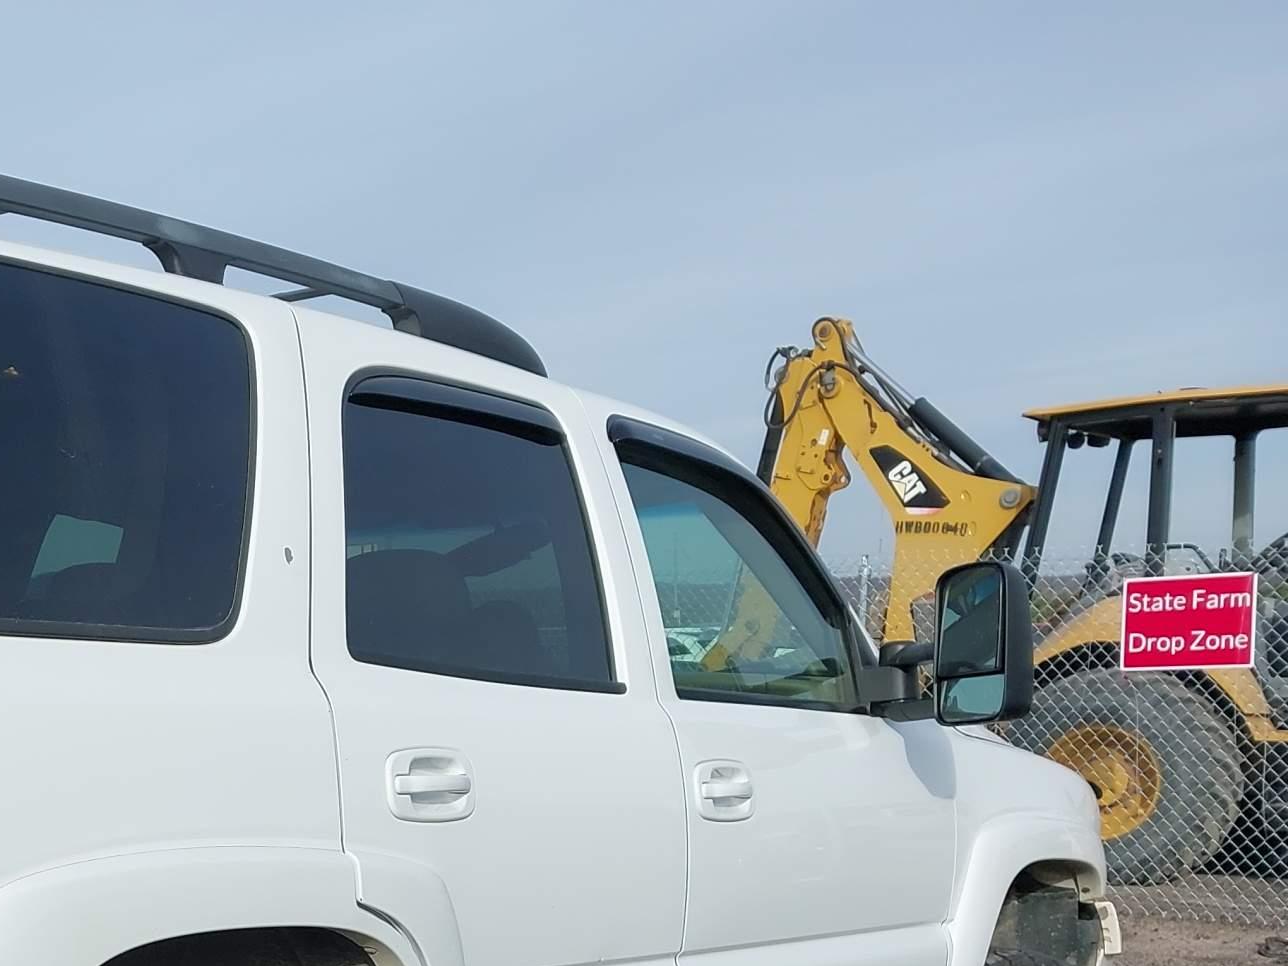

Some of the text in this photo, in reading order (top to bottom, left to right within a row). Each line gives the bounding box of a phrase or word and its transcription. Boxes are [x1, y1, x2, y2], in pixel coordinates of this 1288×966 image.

[889, 460, 927, 504] CAT
[1128, 589, 1251, 613] State Farm
[1128, 630, 1249, 655] Drop Zone
